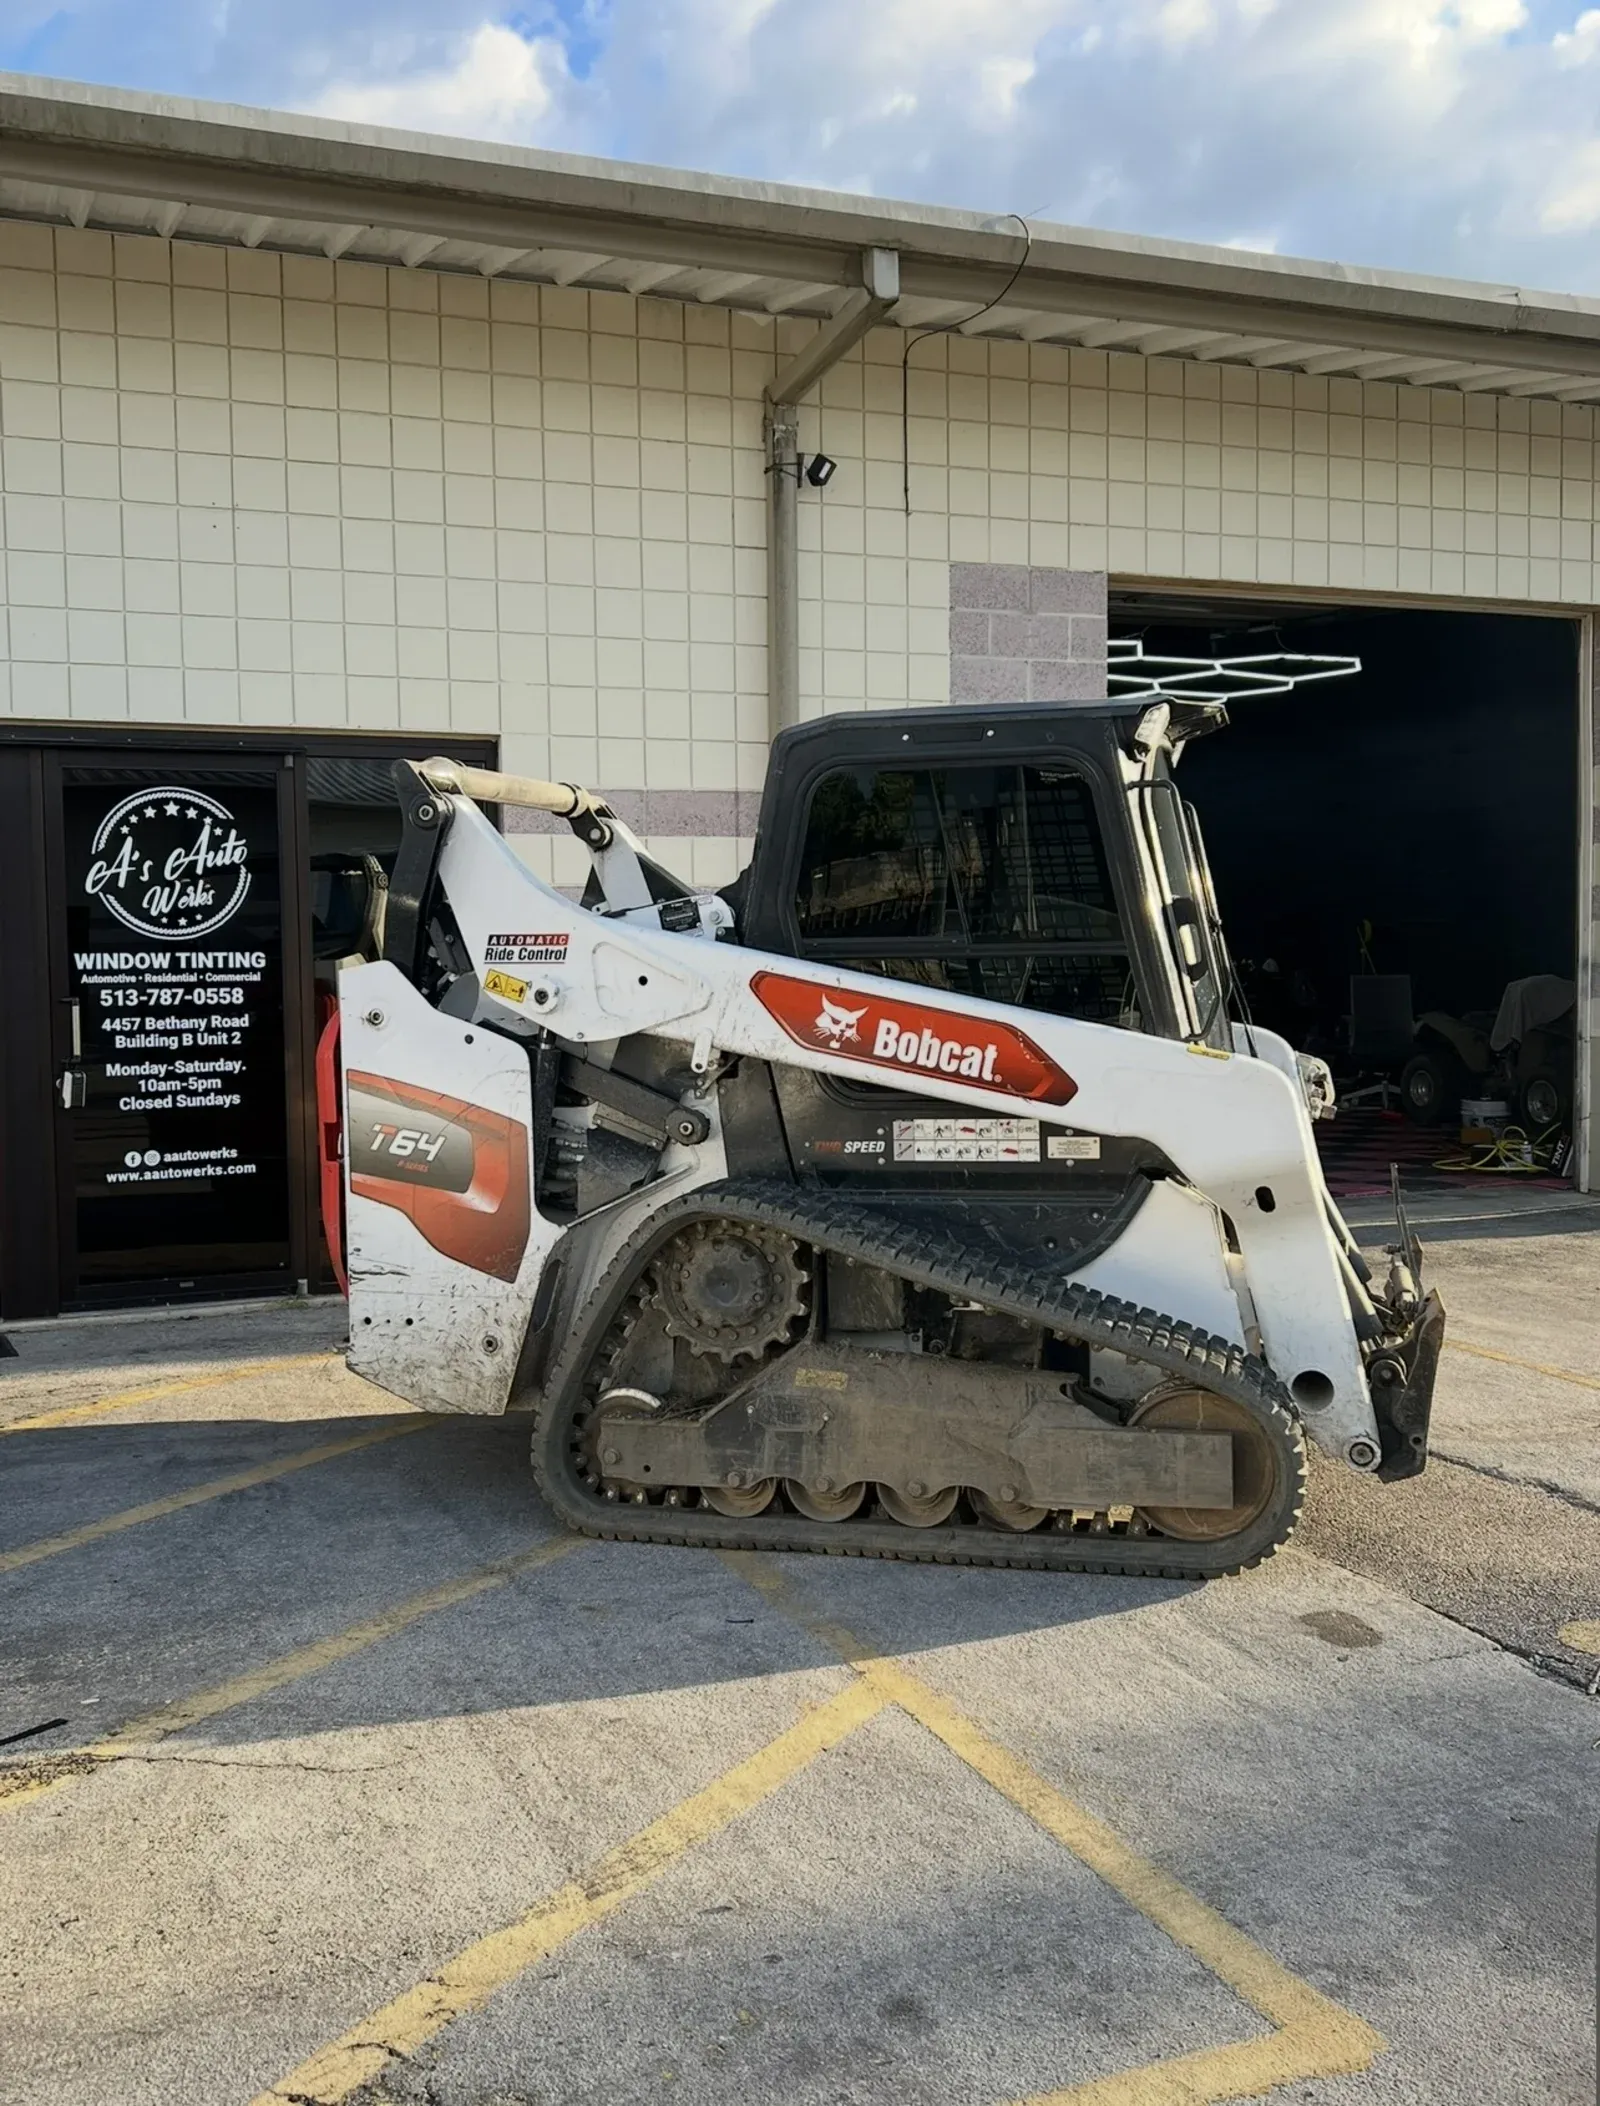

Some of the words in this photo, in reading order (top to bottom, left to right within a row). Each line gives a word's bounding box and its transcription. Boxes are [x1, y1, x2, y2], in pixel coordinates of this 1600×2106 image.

[85, 835, 153, 894] A's
[164, 824, 247, 880] Auto
[142, 879, 215, 916] Werks
[490, 936, 567, 945] AUTOMATIC
[74, 953, 171, 969] WINDOW
[175, 952, 266, 968] TINTING
[484, 948, 514, 960] Ride
[518, 947, 567, 960] Control
[81, 974, 136, 983] Automotive
[144, 973, 197, 982] Residential
[205, 972, 261, 981] Commercial
[100, 988, 244, 1006] 513-787-0558
[101, 1018, 141, 1031] 4457
[145, 1016, 207, 1031] Bethany
[211, 1014, 249, 1028] Road
[115, 1034, 178, 1049] Building
[182, 1033, 193, 1046] B
[197, 1032, 228, 1045] Unit
[231, 1032, 242, 1044] 2
[873, 1018, 999, 1082] Bobcat
[138, 1077, 222, 1093] 10am-5pm
[119, 1095, 172, 1110] Closed
[176, 1092, 241, 1108] Sundays
[370, 1123, 446, 1162] T64
[844, 1141, 886, 1153] SPEED
[163, 1147, 238, 1162] aautowerks
[106, 1164, 257, 1183] www.aautowerks.com
